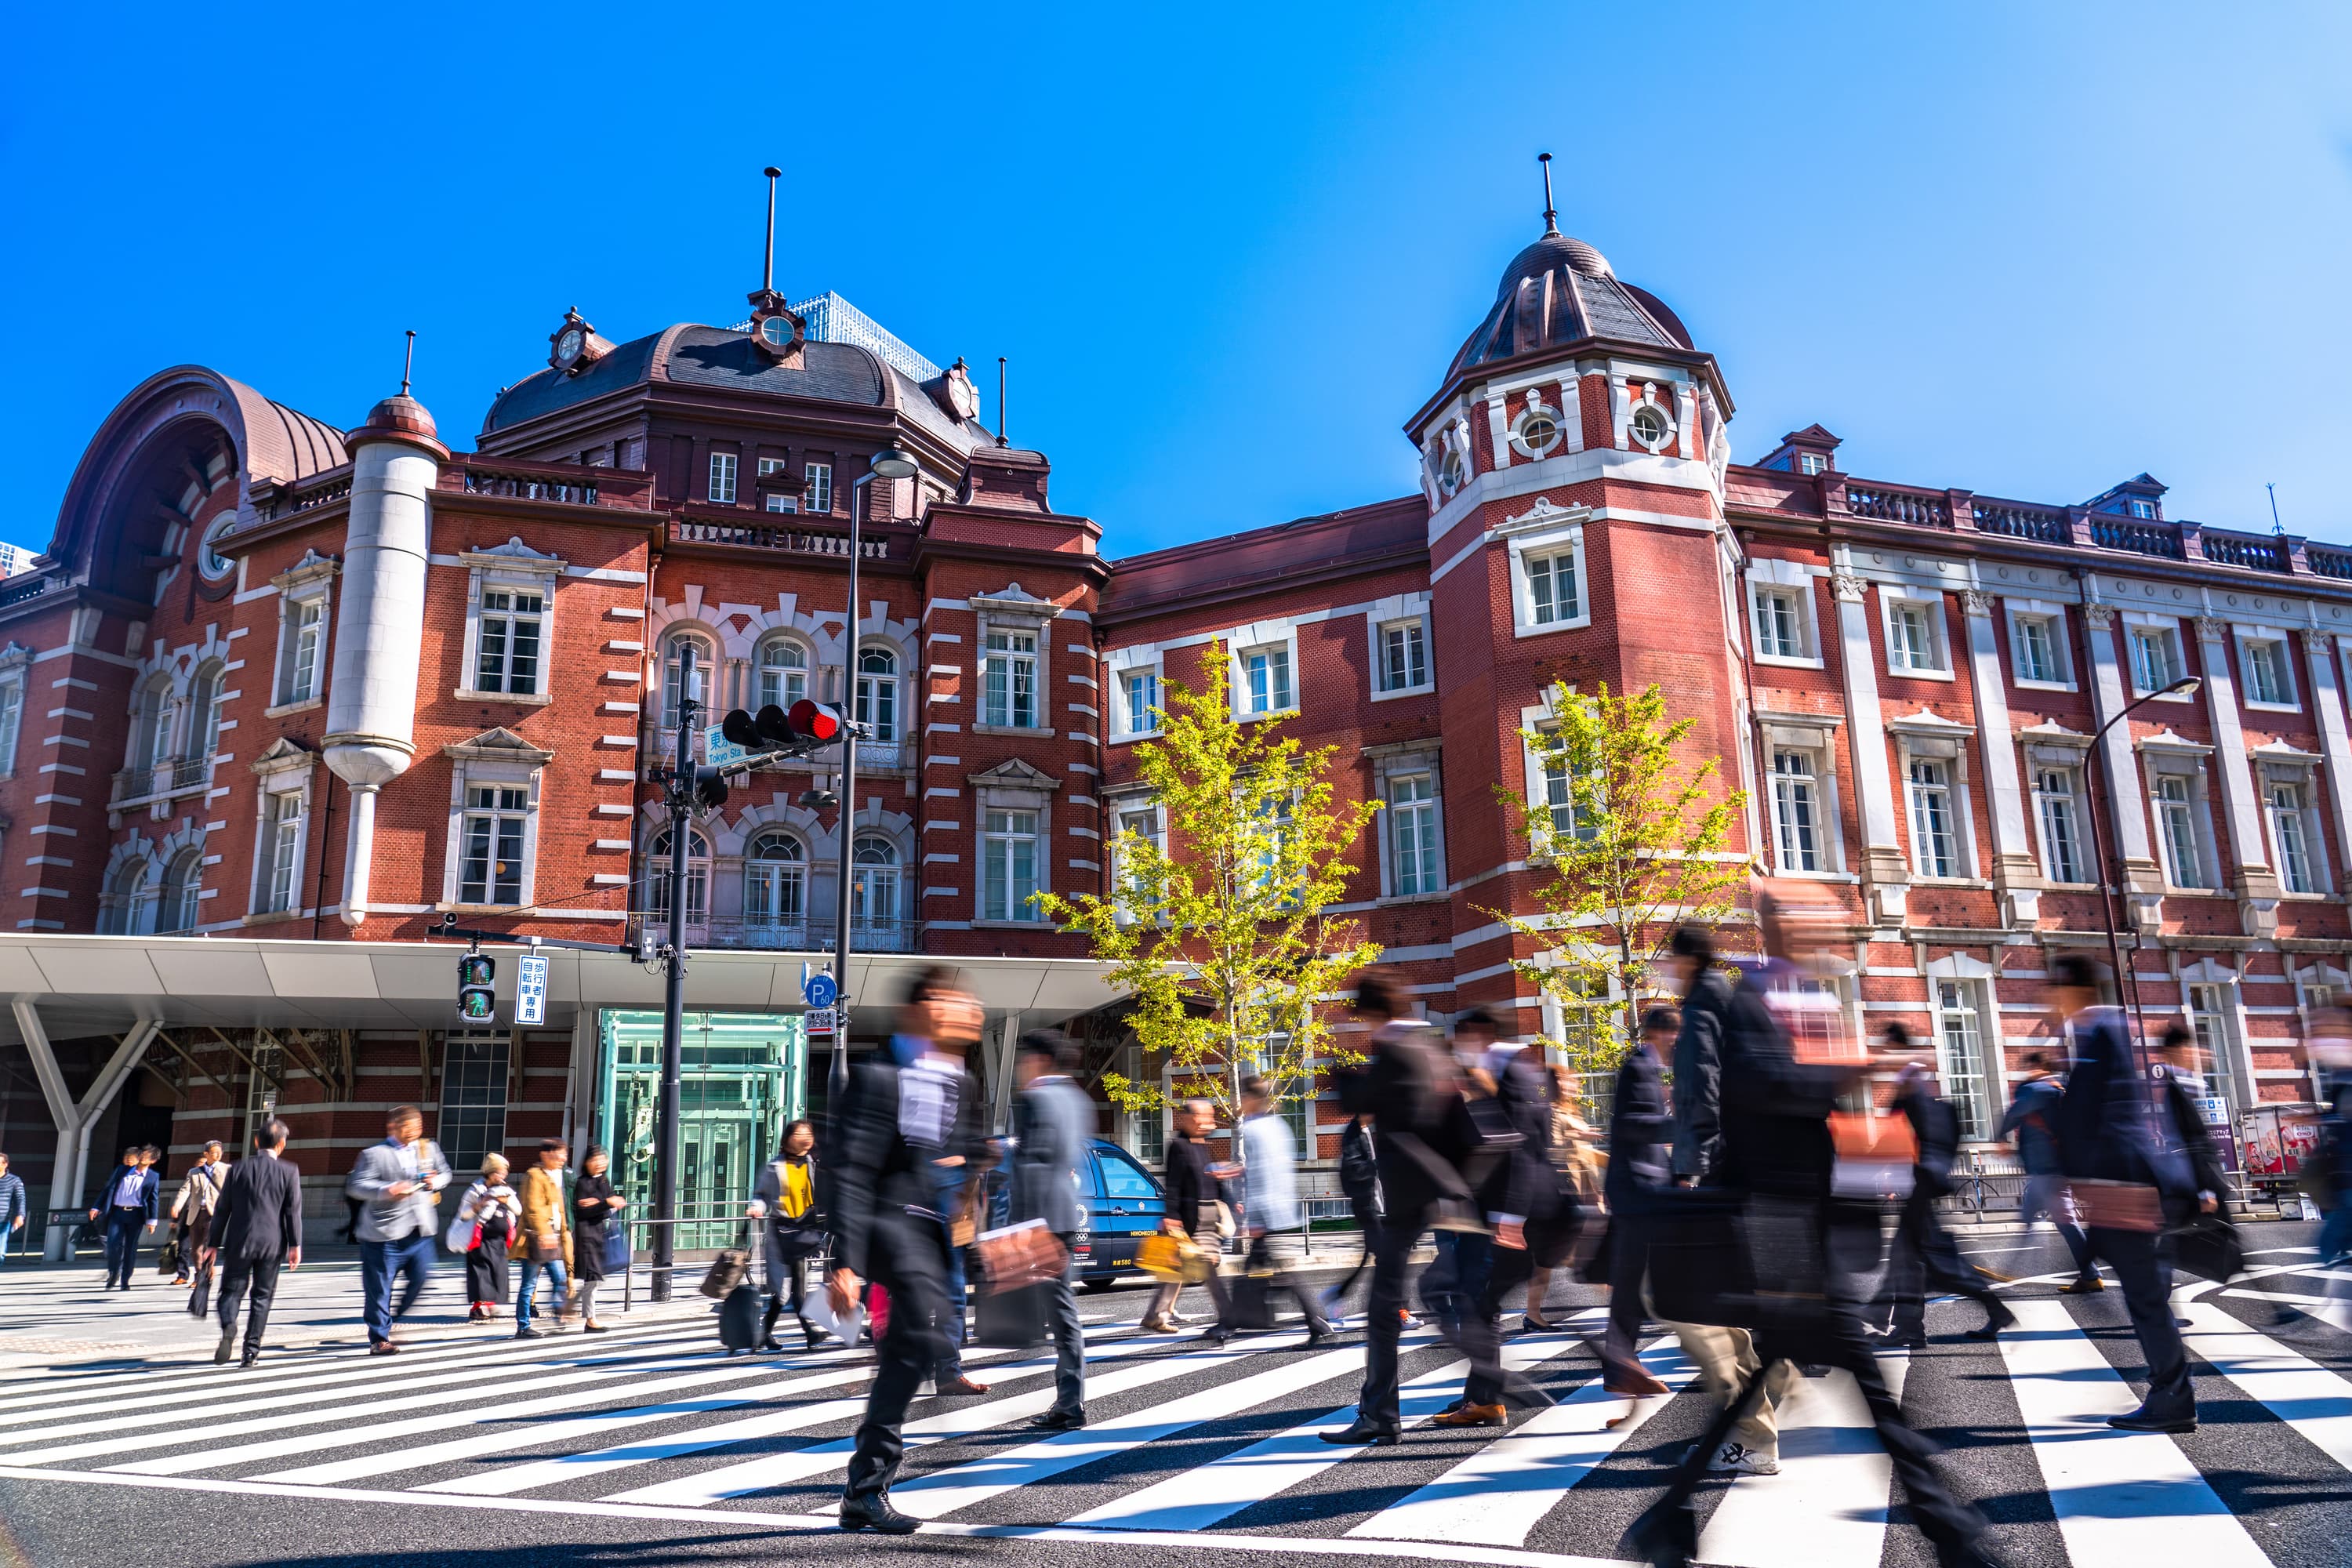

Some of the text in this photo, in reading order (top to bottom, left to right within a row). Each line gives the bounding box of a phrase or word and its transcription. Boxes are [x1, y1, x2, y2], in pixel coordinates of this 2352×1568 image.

[709, 748, 743, 764] Tokyo Sta.
[521, 961, 533, 994] 自転車
[532, 963, 544, 996] 歩行者
[812, 984, 825, 1004] P
[820, 995, 829, 1004] 60
[525, 996, 536, 1019] 専用
